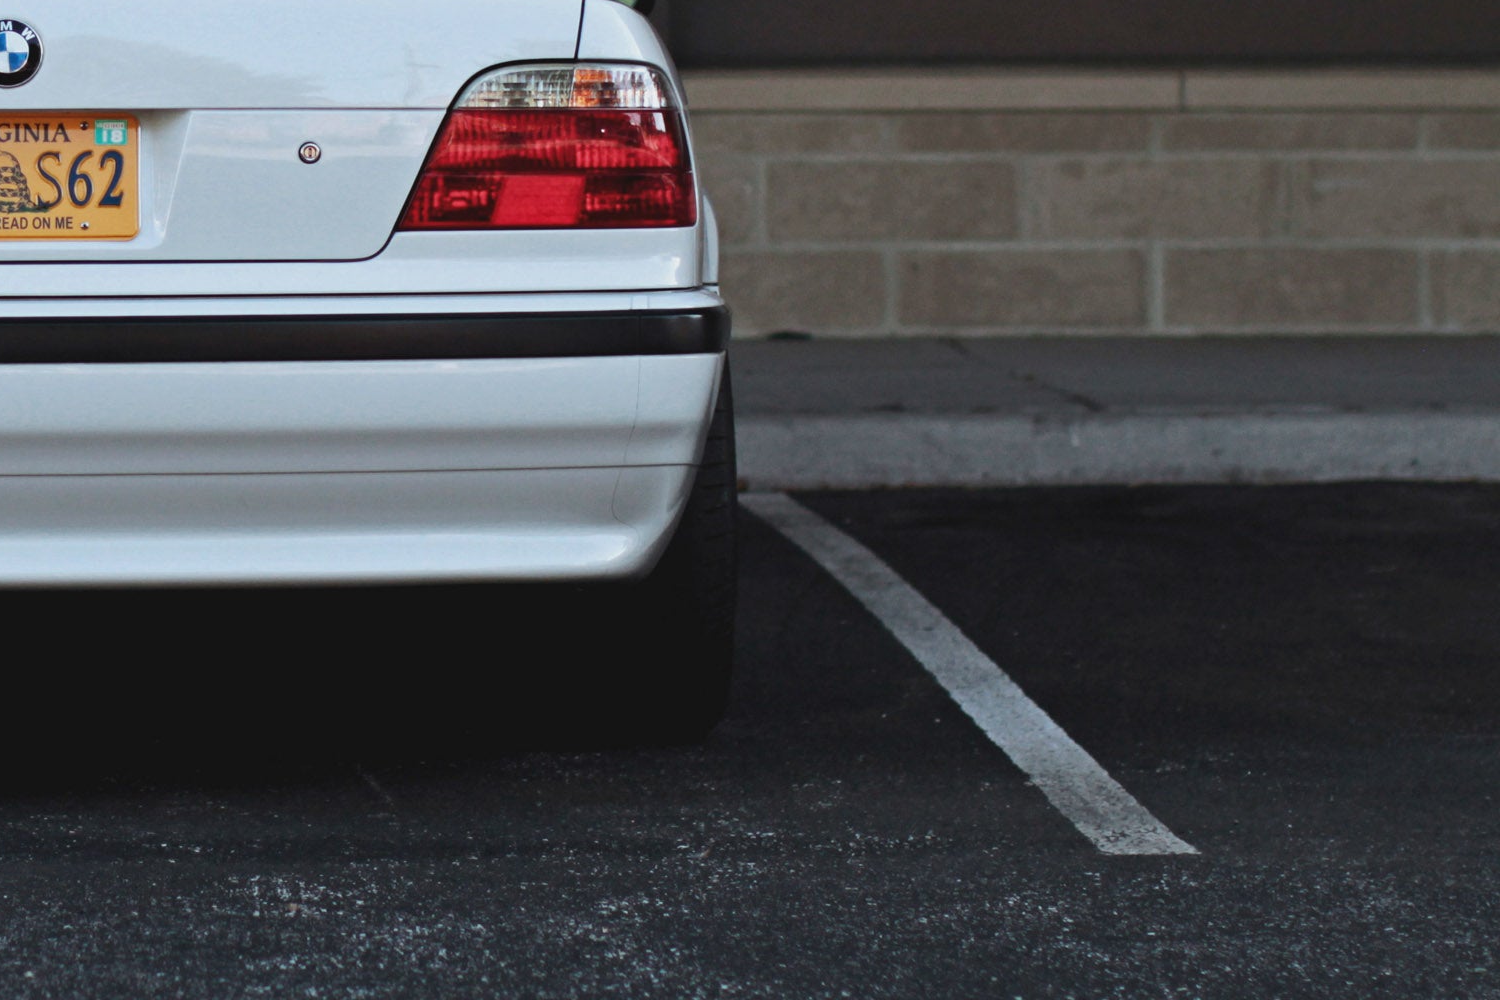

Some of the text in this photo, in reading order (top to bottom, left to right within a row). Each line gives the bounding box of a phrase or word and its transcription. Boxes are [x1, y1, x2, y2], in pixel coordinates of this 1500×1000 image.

[102, 129, 123, 143] 18
[35, 149, 124, 208] S62
[32, 217, 50, 230] ON
[55, 217, 73, 230] ME
